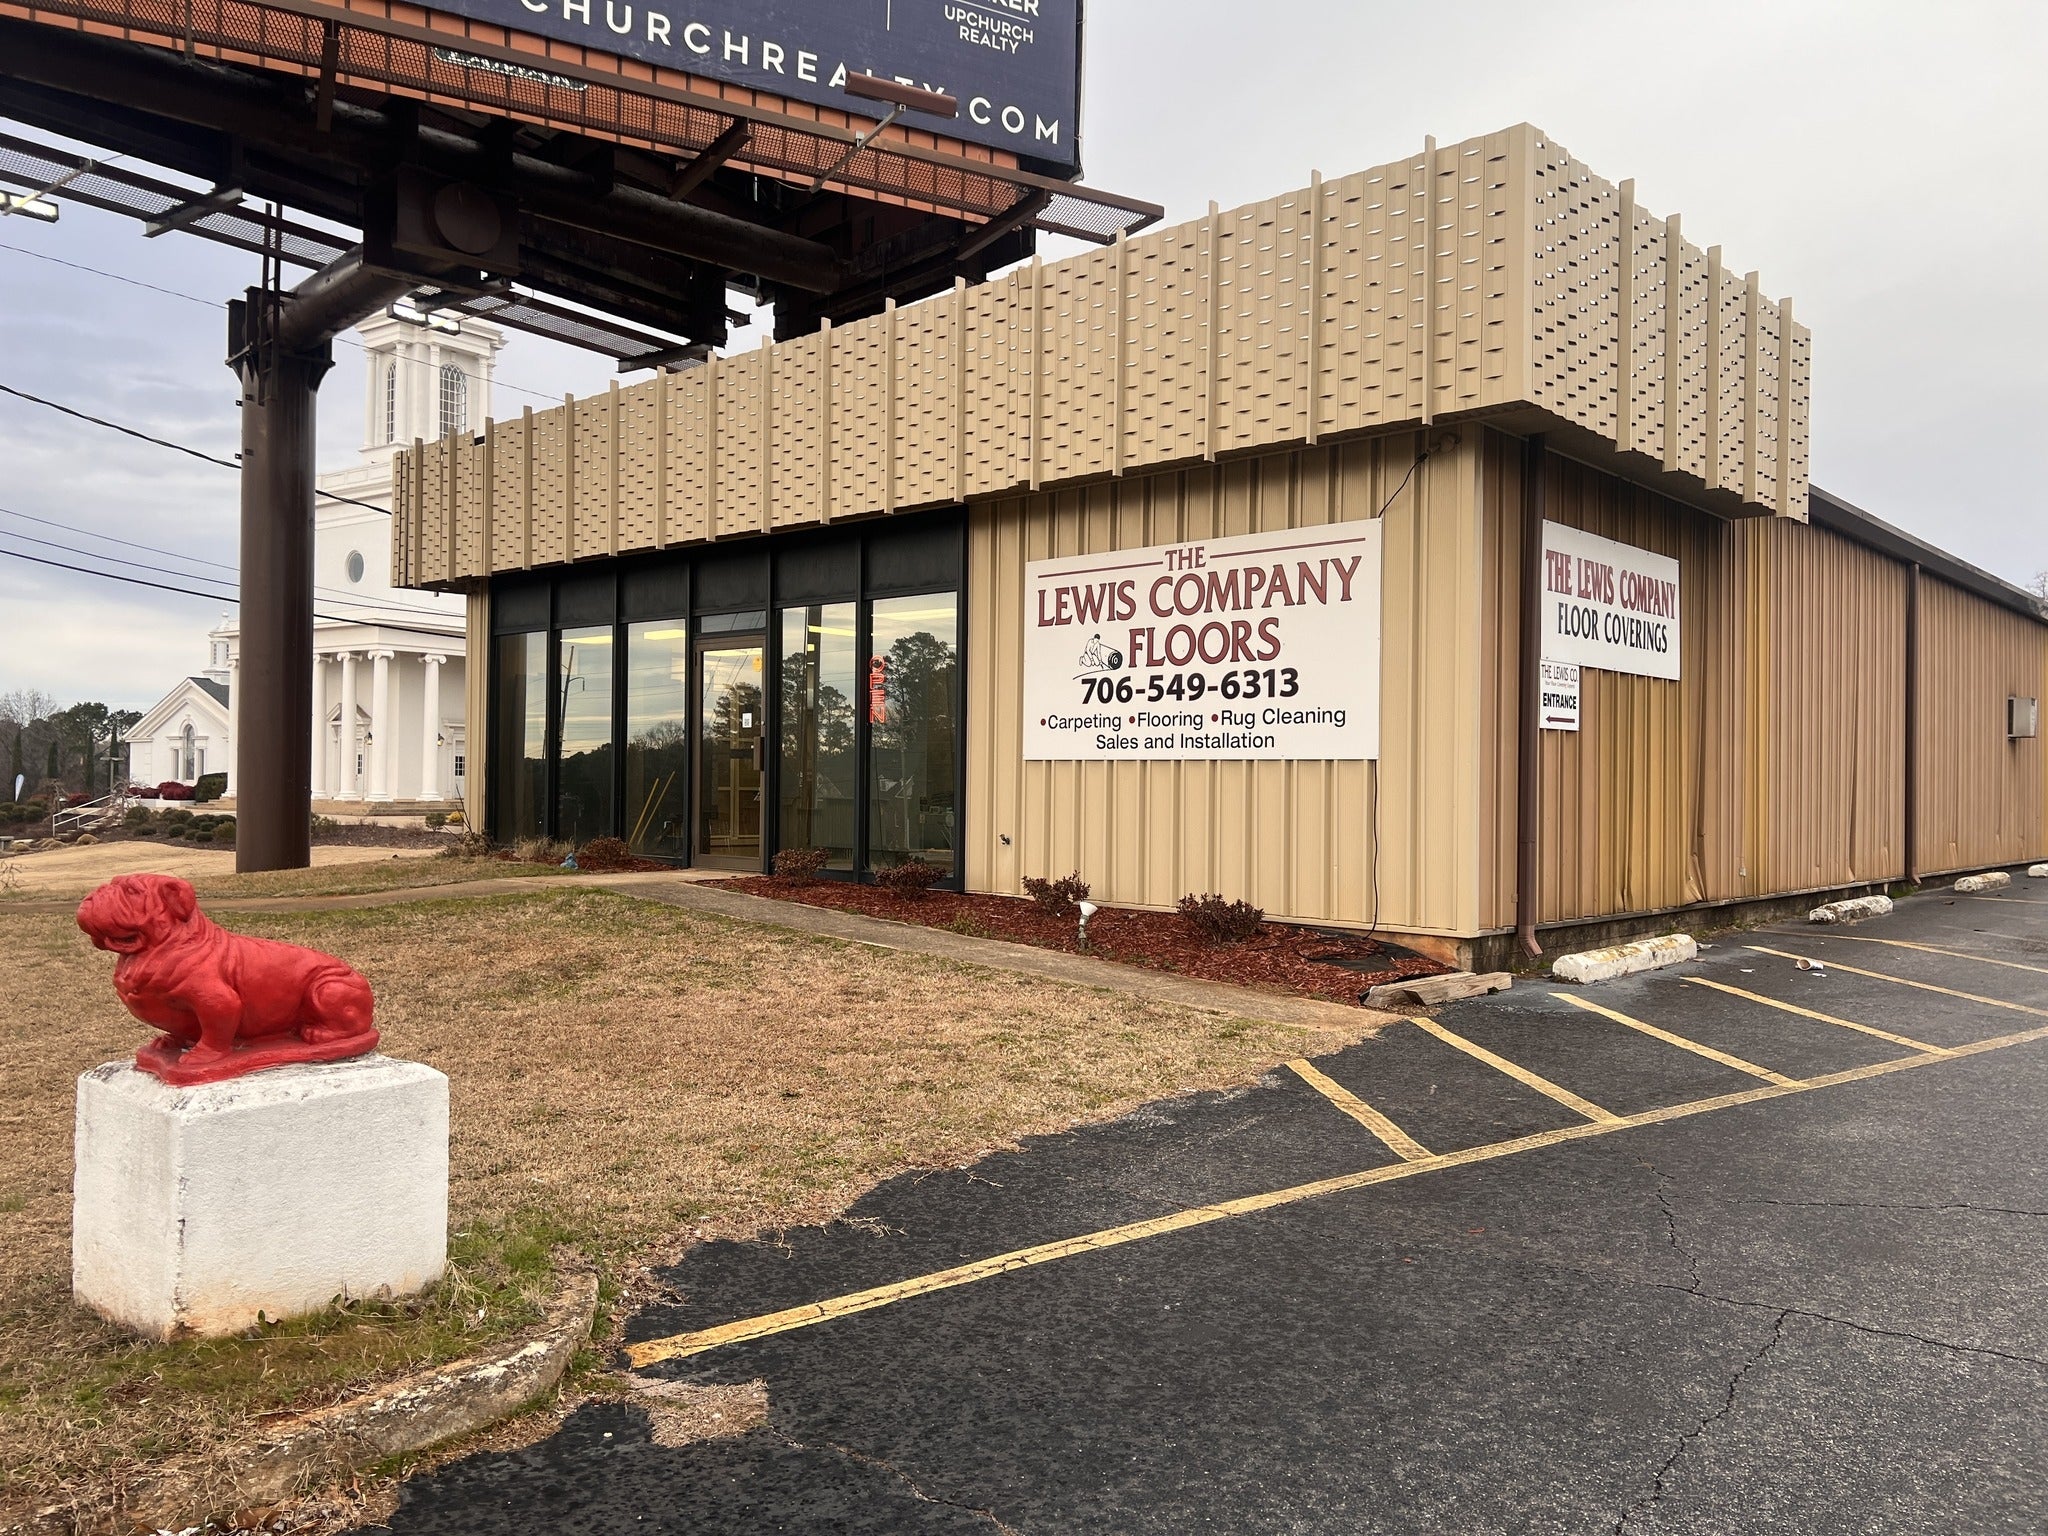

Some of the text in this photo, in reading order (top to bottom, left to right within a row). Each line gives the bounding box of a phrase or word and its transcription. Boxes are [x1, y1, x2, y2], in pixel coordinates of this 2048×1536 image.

[944, 4, 1034, 44] UPCHURCH
[959, 25, 1019, 54] REALTY
[1165, 547, 1206, 571] THE
[1038, 556, 1362, 627] LEWIS COMPANY
[1545, 549, 1676, 619] THE LEWIS COMPANY
[1128, 618, 1281, 668] FLOORS
[1558, 602, 1668, 653] FLOOR COVERINGS
[869, 655, 886, 723] OPEN
[1081, 667, 1299, 704] 706-549-6313
[1541, 664, 1551, 678] THE
[1553, 665, 1568, 680] LEWIS
[1262, 707, 1347, 729] Cleaning
[1543, 692, 1576, 709] ENTRANCE
[1096, 733, 1275, 750] Sales and Installation
